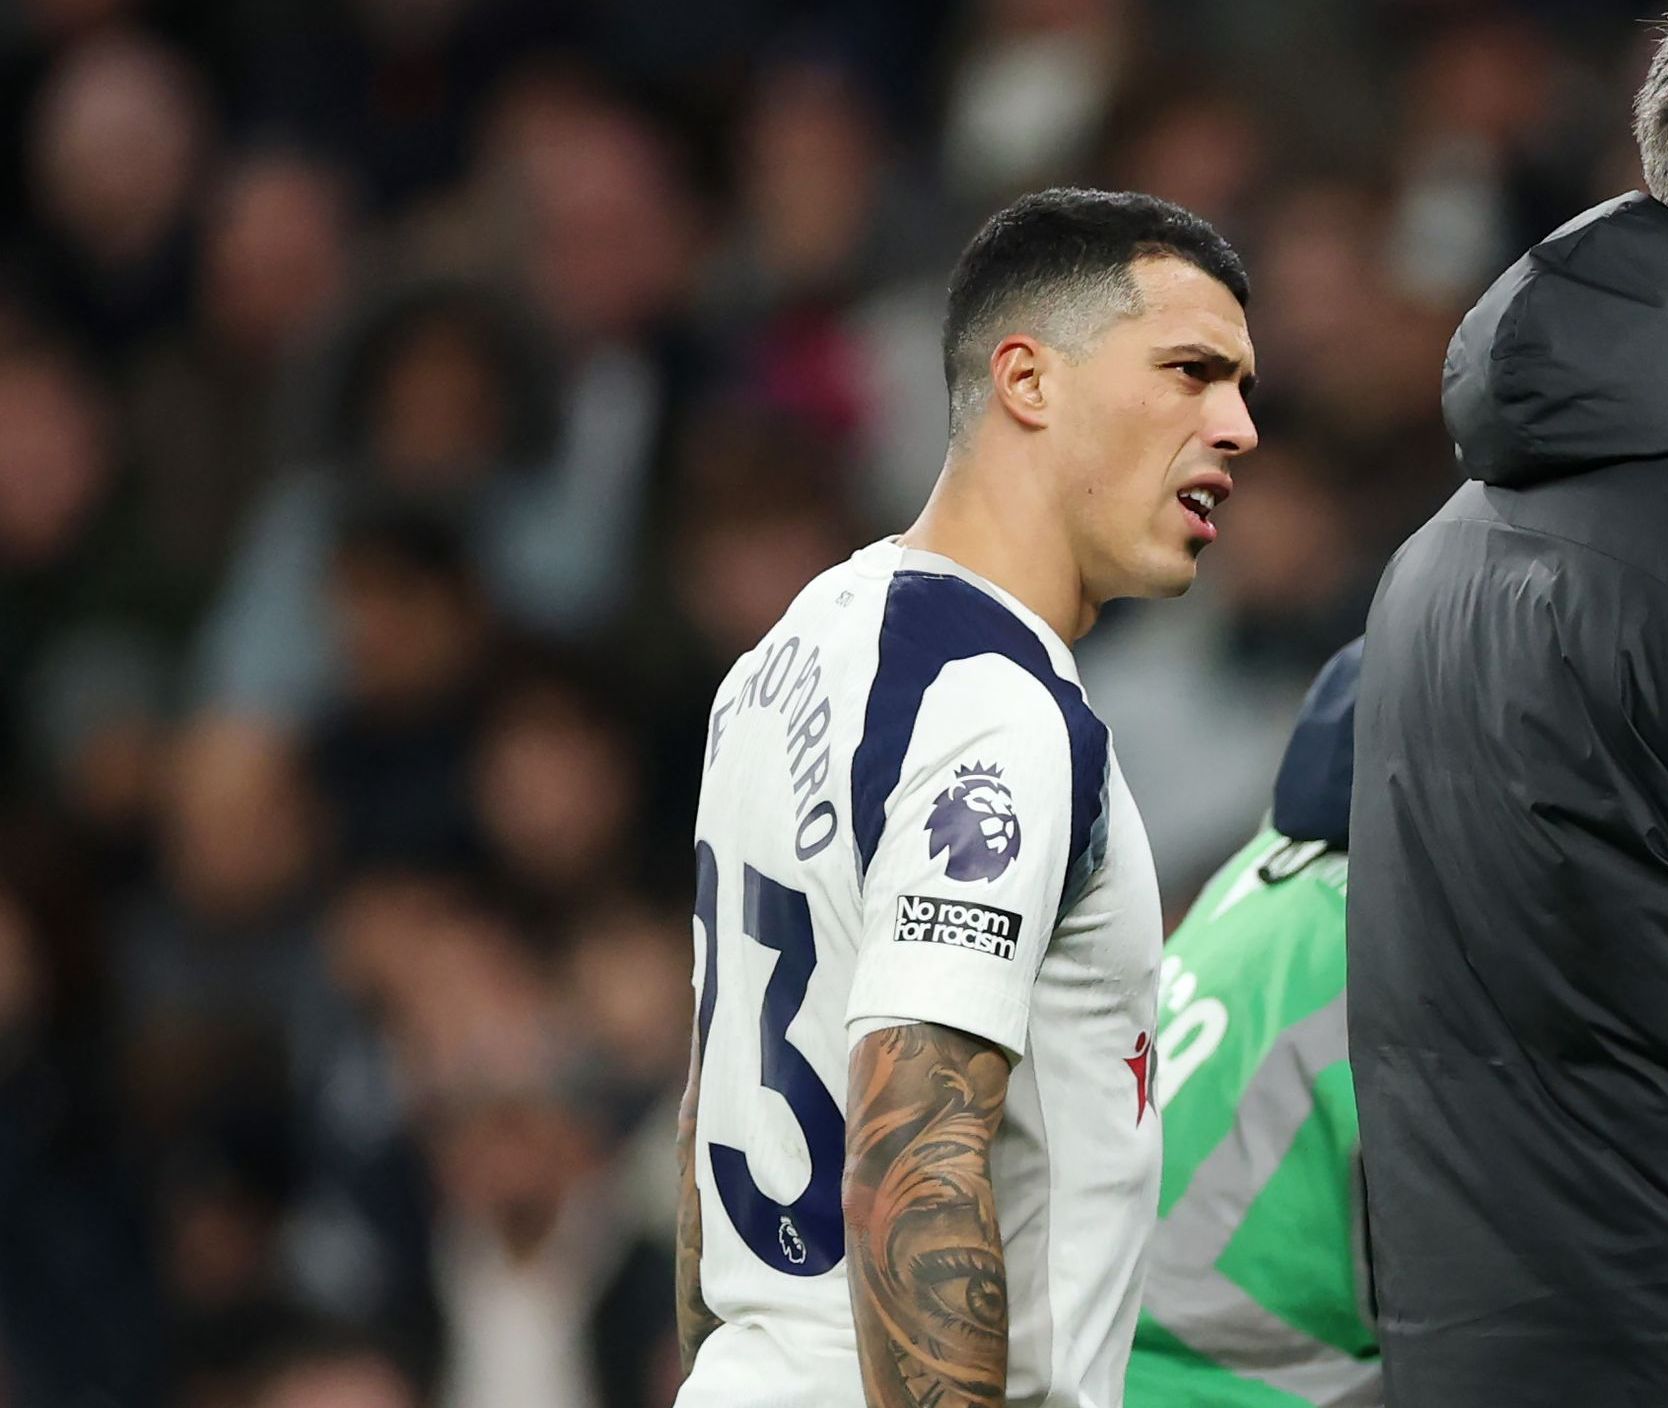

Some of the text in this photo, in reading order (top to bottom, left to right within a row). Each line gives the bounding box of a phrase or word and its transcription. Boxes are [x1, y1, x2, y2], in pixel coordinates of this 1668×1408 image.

[898, 896, 1010, 936] No room
[894, 917, 1016, 960] for racism
[692, 838, 847, 1277] 3
